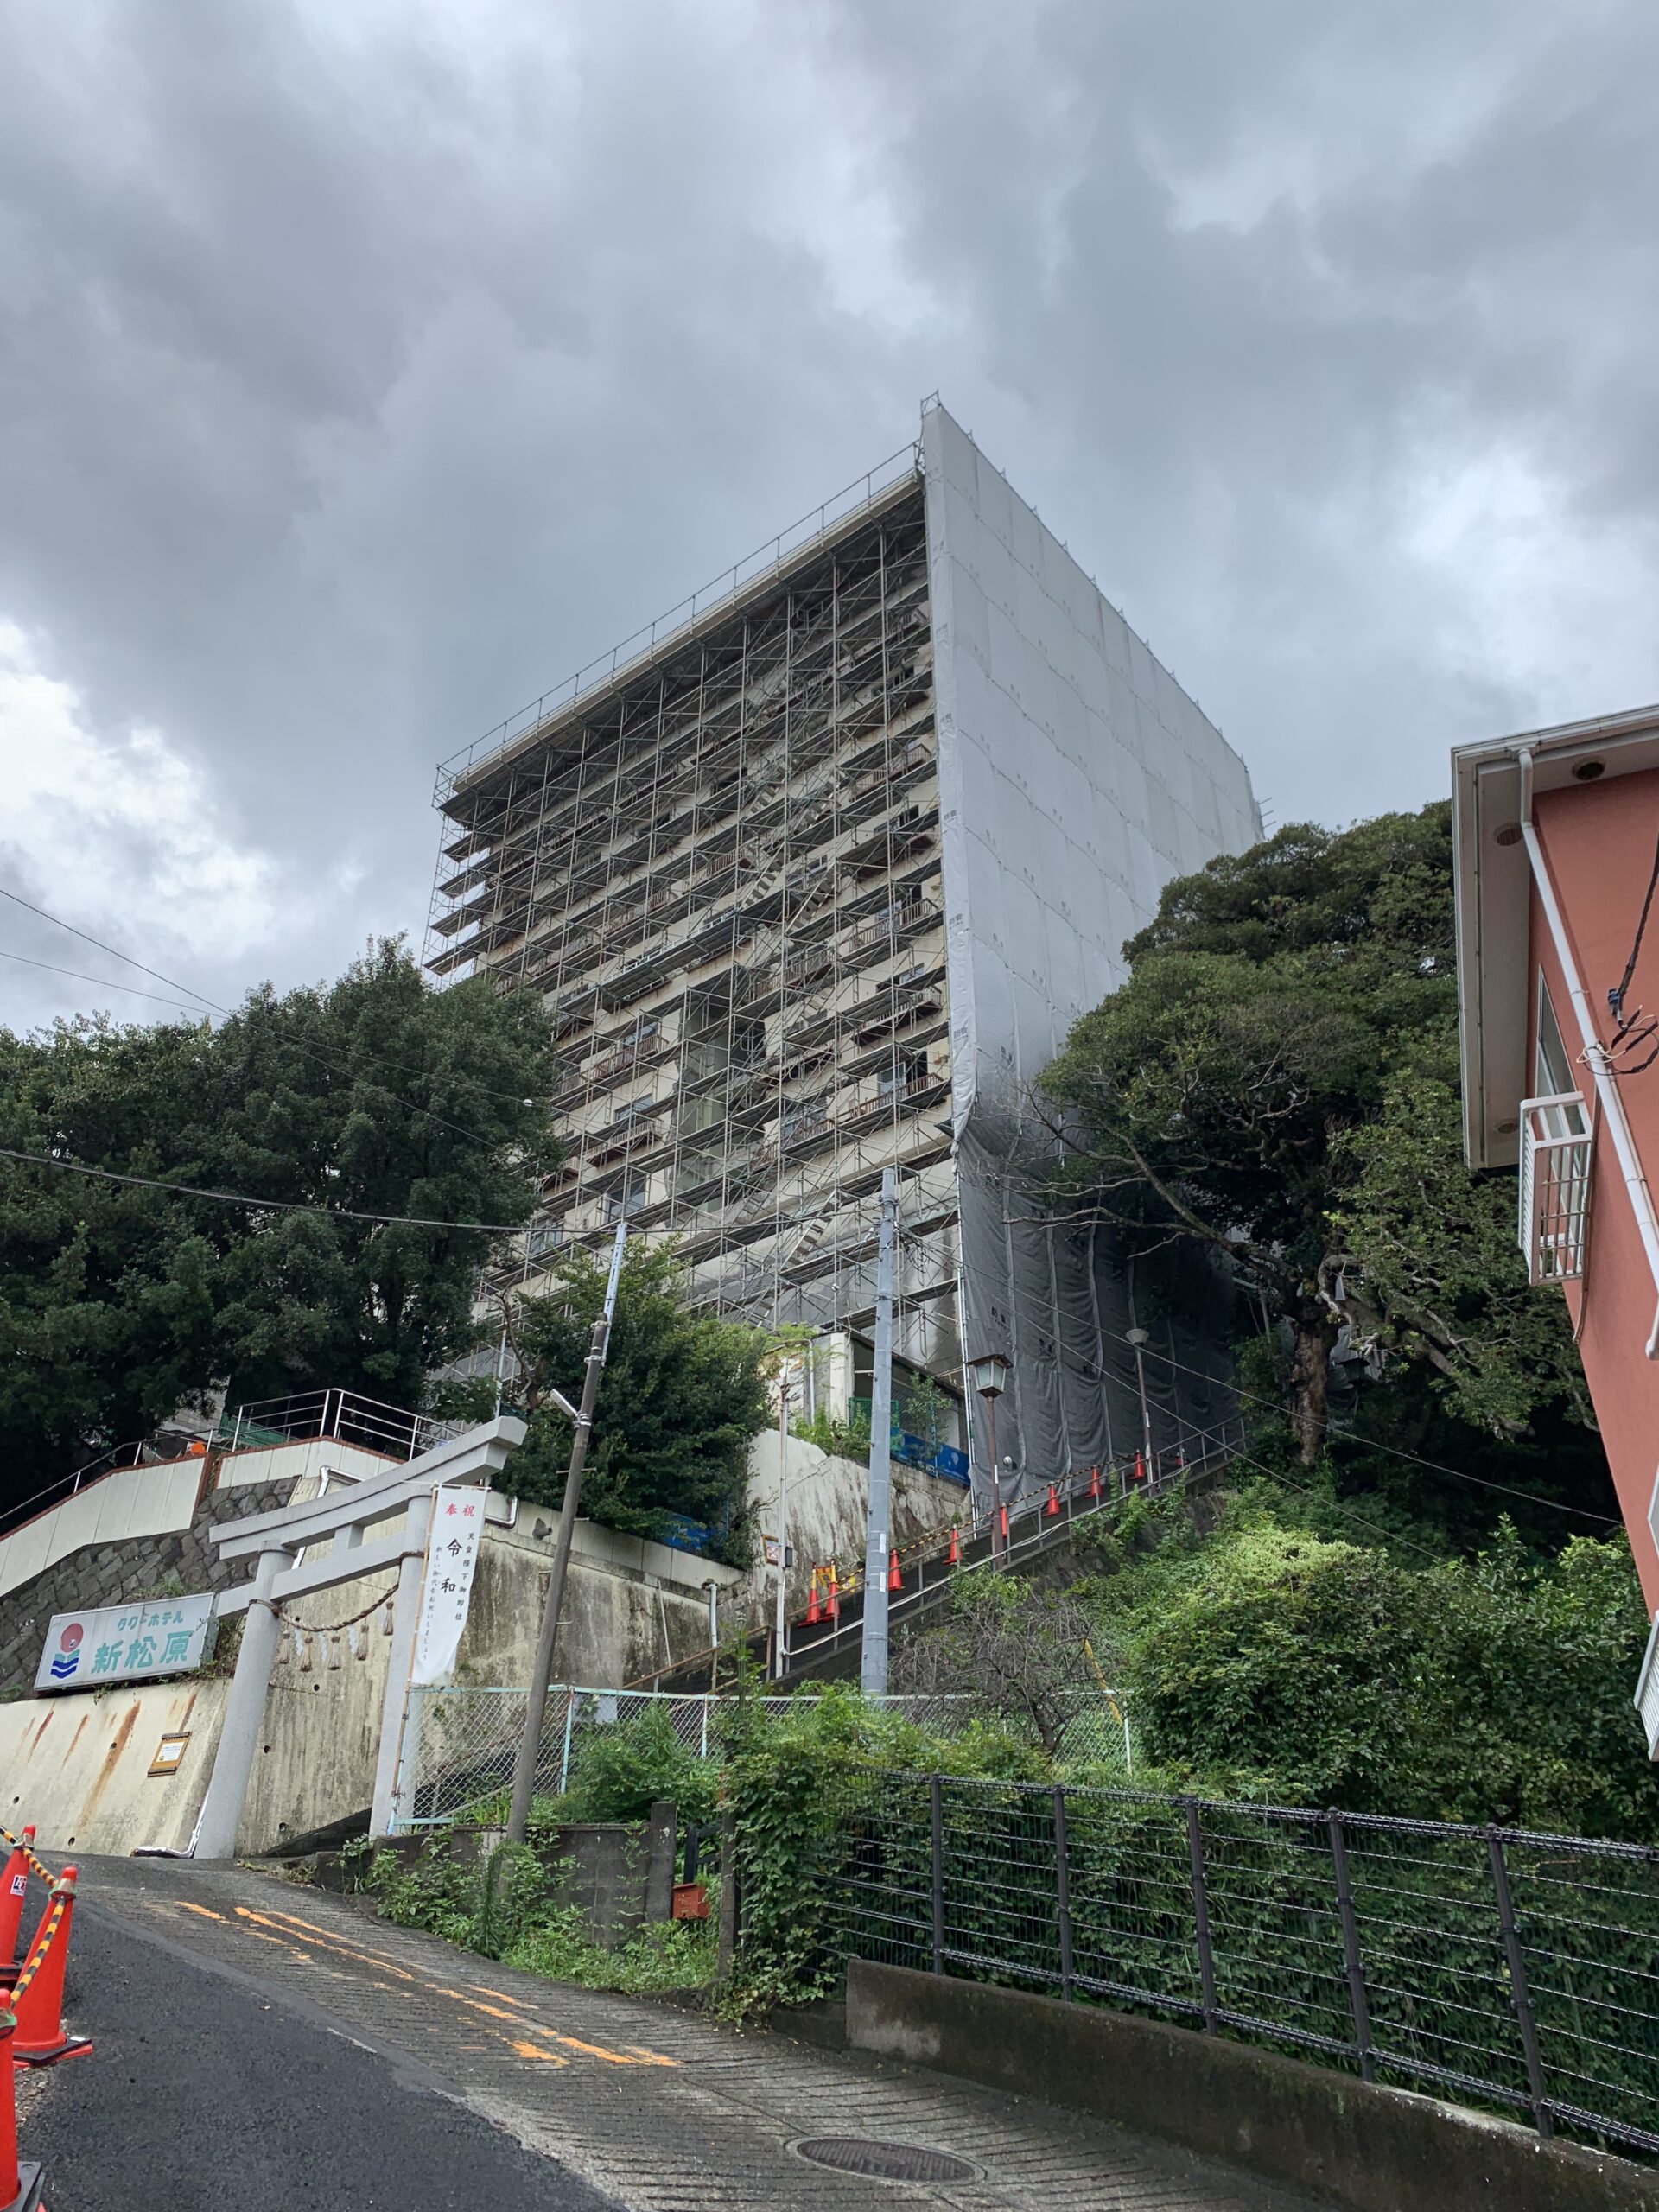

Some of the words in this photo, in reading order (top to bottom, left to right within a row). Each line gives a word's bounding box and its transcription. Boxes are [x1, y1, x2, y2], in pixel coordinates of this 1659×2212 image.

[445, 1503, 475, 1517] 奉祝
[440, 1538, 463, 1594] 令和
[454, 1532, 475, 1621] 天皇陛下御即位
[117, 1610, 184, 1632] タワーホテル
[90, 1630, 194, 1675] 新松原
